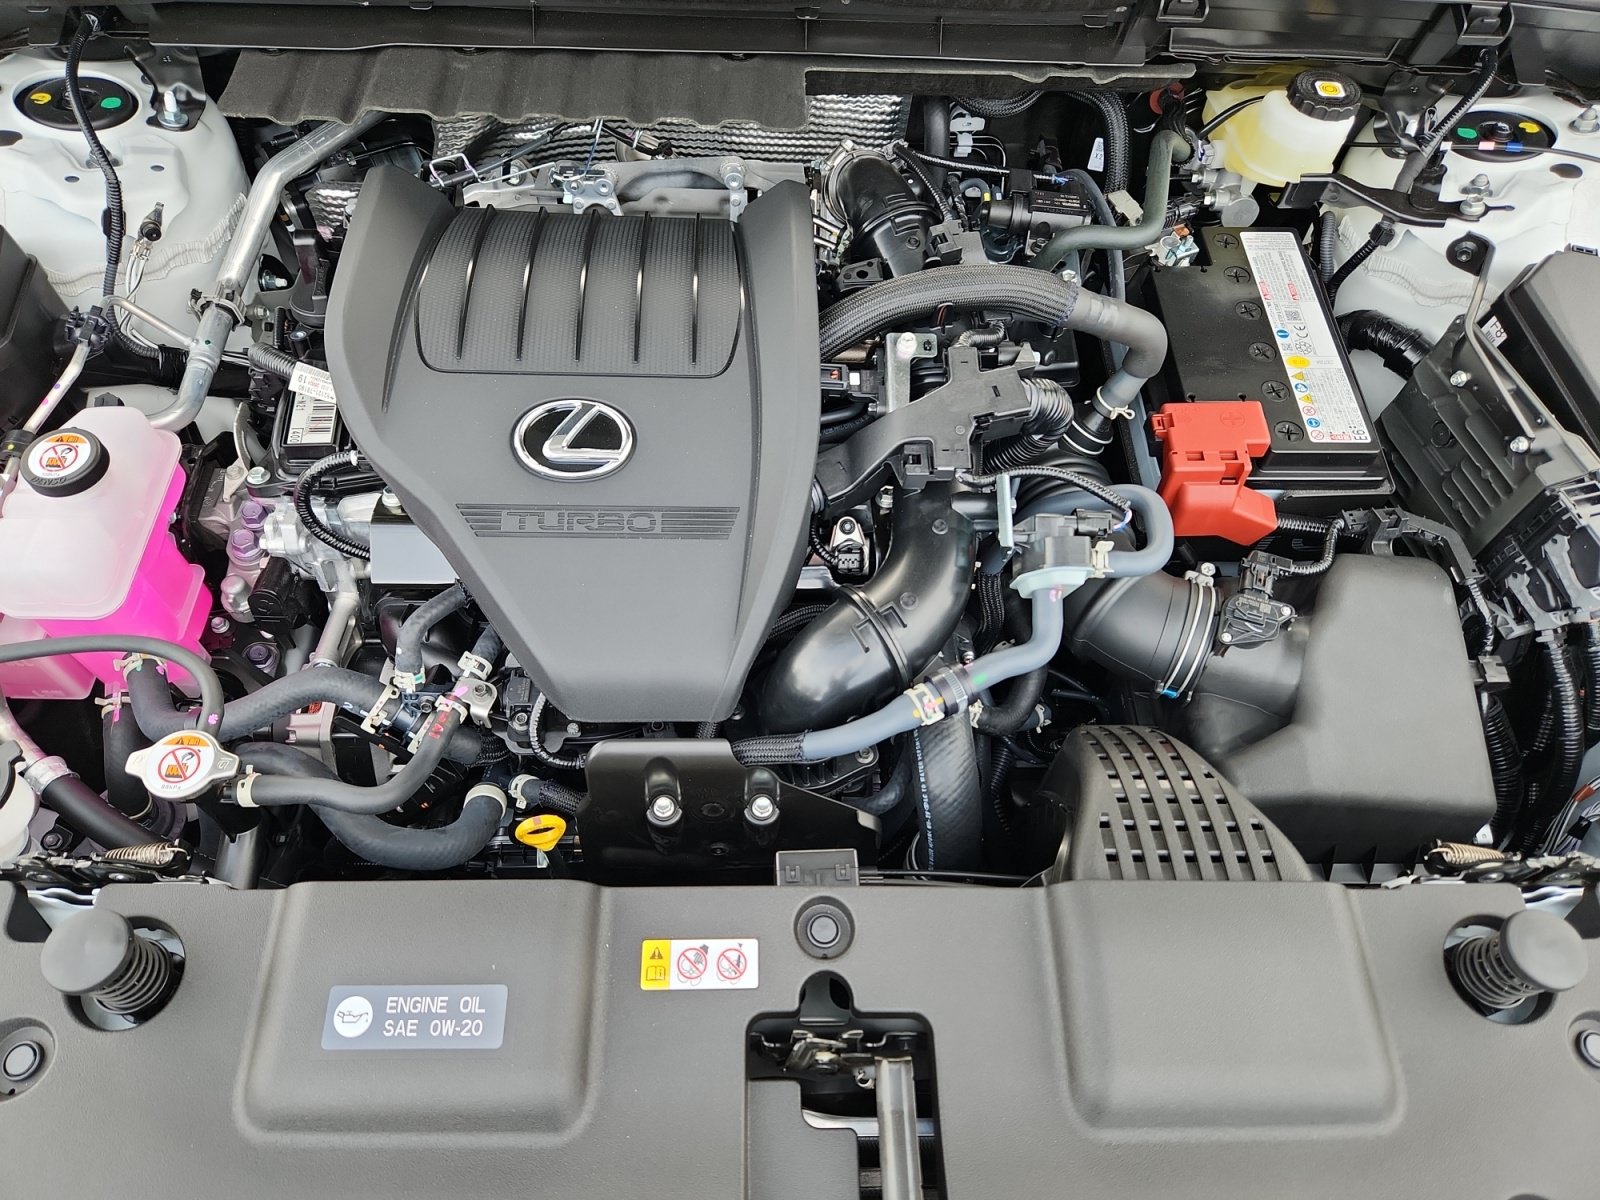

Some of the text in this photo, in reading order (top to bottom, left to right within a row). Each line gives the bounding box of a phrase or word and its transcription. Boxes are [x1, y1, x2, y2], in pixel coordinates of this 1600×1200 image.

[289, 431, 301, 443] 400
[31, 476, 67, 486] DENSO
[506, 511, 657, 532] TURBO
[386, 995, 486, 1013] ENGINE OIL
[383, 1019, 484, 1037] SAE 0W-20
